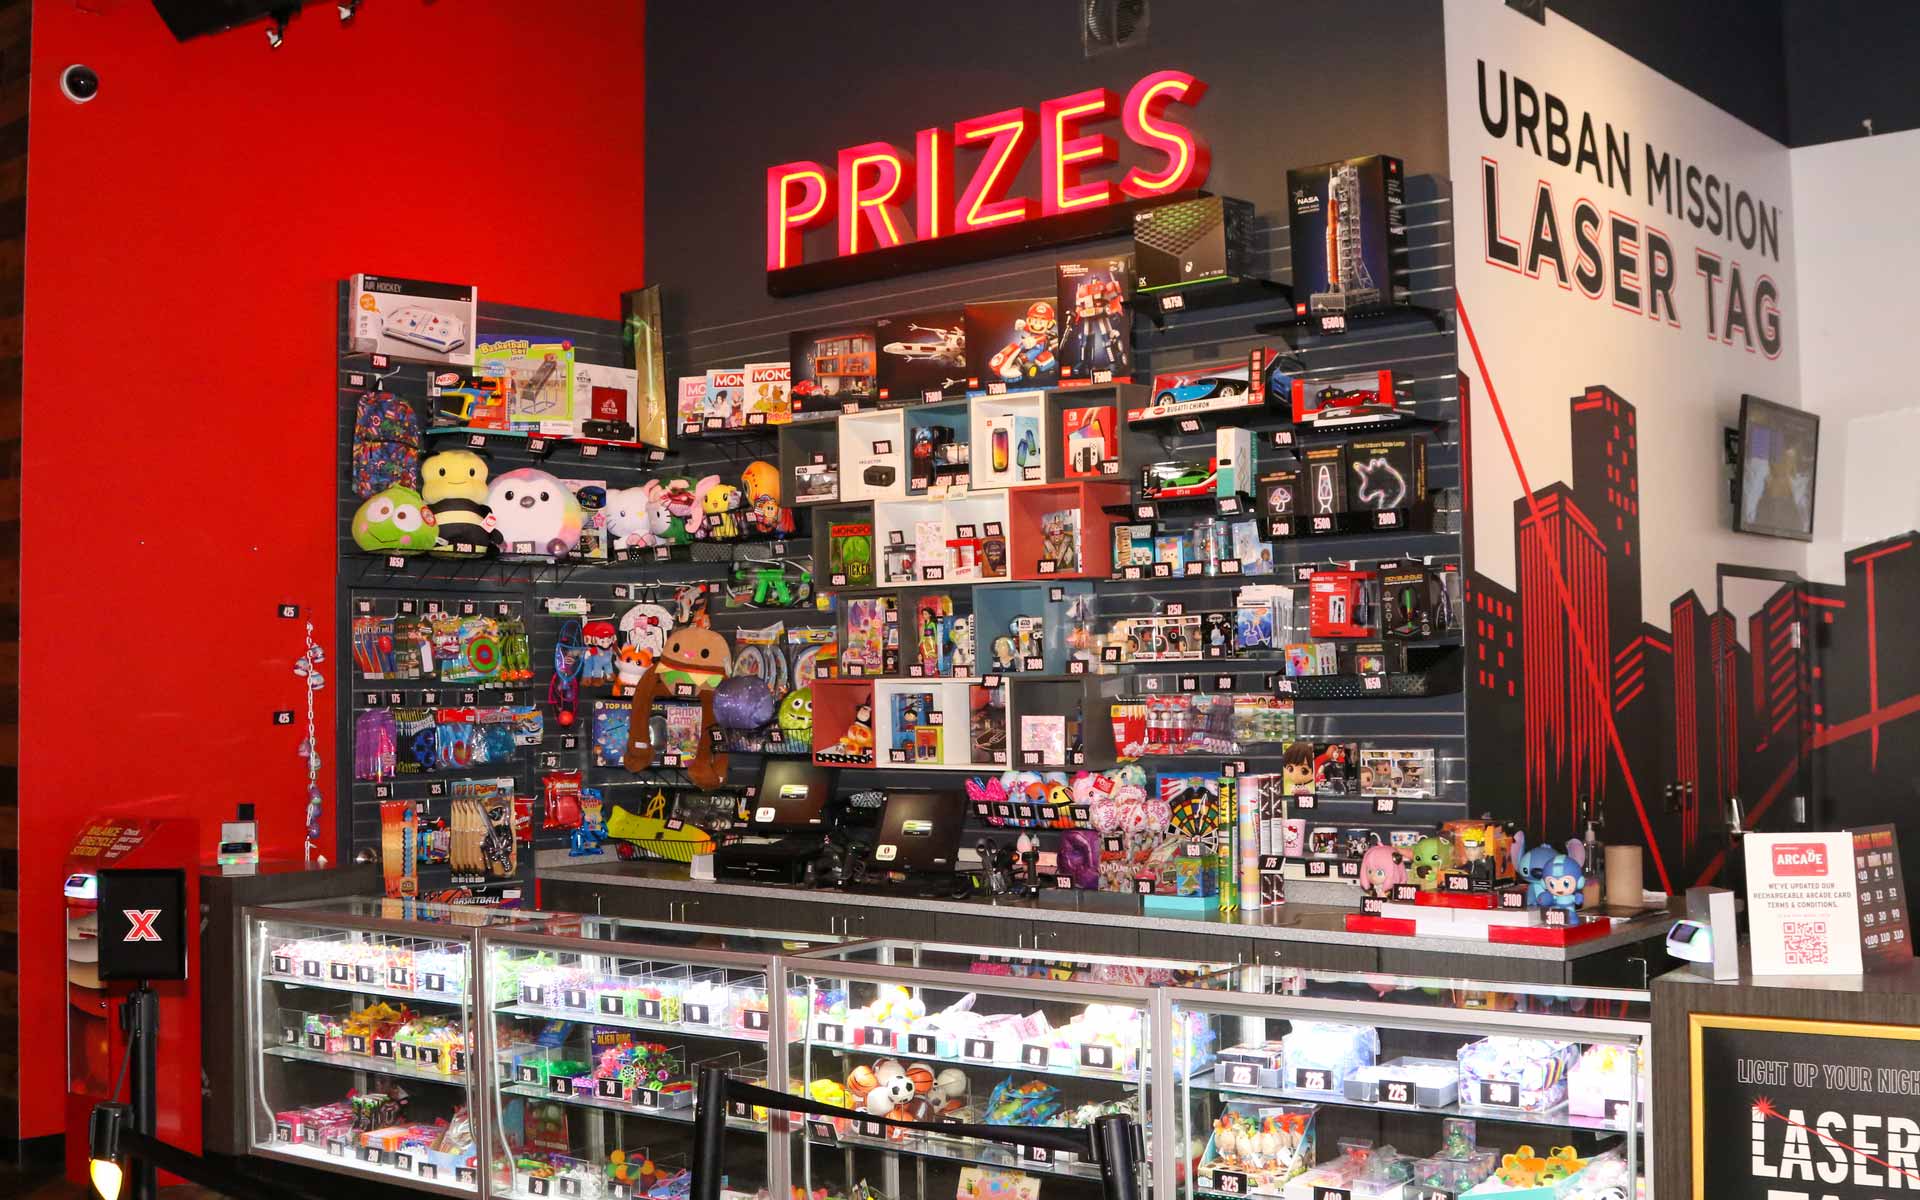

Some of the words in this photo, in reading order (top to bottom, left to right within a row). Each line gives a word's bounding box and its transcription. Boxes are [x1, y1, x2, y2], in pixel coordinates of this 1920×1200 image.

[1477, 58, 1632, 196] URBAN
[1645, 143, 1779, 262] MISSION
[767, 70, 1211, 271] PRIZES
[1297, 196, 1319, 205] NASA
[1481, 156, 1680, 328] LASER
[1695, 248, 1782, 360] TAG
[376, 281, 402, 293] HOCKEY
[480, 340, 528, 355] Basketball
[511, 347, 528, 356] Set
[436, 373, 459, 385] NERF
[1167, 403, 1189, 413] BUGATTI
[1189, 401, 1210, 411] CHIRON
[1276, 432, 1292, 444] 4700
[1272, 524, 1289, 536] 2300
[1314, 518, 1330, 530] 2500
[926, 568, 942, 578] 2200
[1364, 677, 1381, 689] 1650
[278, 713, 290, 723] 425
[1220, 786, 1229, 824] WASTE
[1266, 858, 1276, 868] 175
[1777, 849, 1824, 865] ARCADE
[1310, 862, 1325, 874] 1350
[1342, 862, 1358, 875] 1450
[1450, 877, 1468, 890] 2500
[1398, 886, 1416, 900] 3100
[453, 895, 500, 905] BASKETBALL
[1364, 899, 1382, 912] 3300
[1504, 894, 1522, 907] 3100
[1546, 911, 1565, 924] 3100
[123, 909, 163, 941] X
[523, 1069, 531, 1081] 20
[1232, 1066, 1251, 1084] 225
[1305, 1071, 1324, 1089] 225
[1737, 1058, 1789, 1086] LIGHT
[1793, 1062, 1819, 1088] UP
[1823, 1064, 1872, 1092] YOUR
[556, 1080, 565, 1093] 20
[606, 1081, 615, 1094] 20
[1388, 1084, 1407, 1102] 225
[643, 1092, 651, 1106] 20
[1032, 1147, 1046, 1160] 125
[1751, 1105, 1920, 1191] LASER
[534, 1180, 543, 1194] 30
[1221, 1175, 1239, 1192] 325
[614, 1184, 623, 1200] 40
